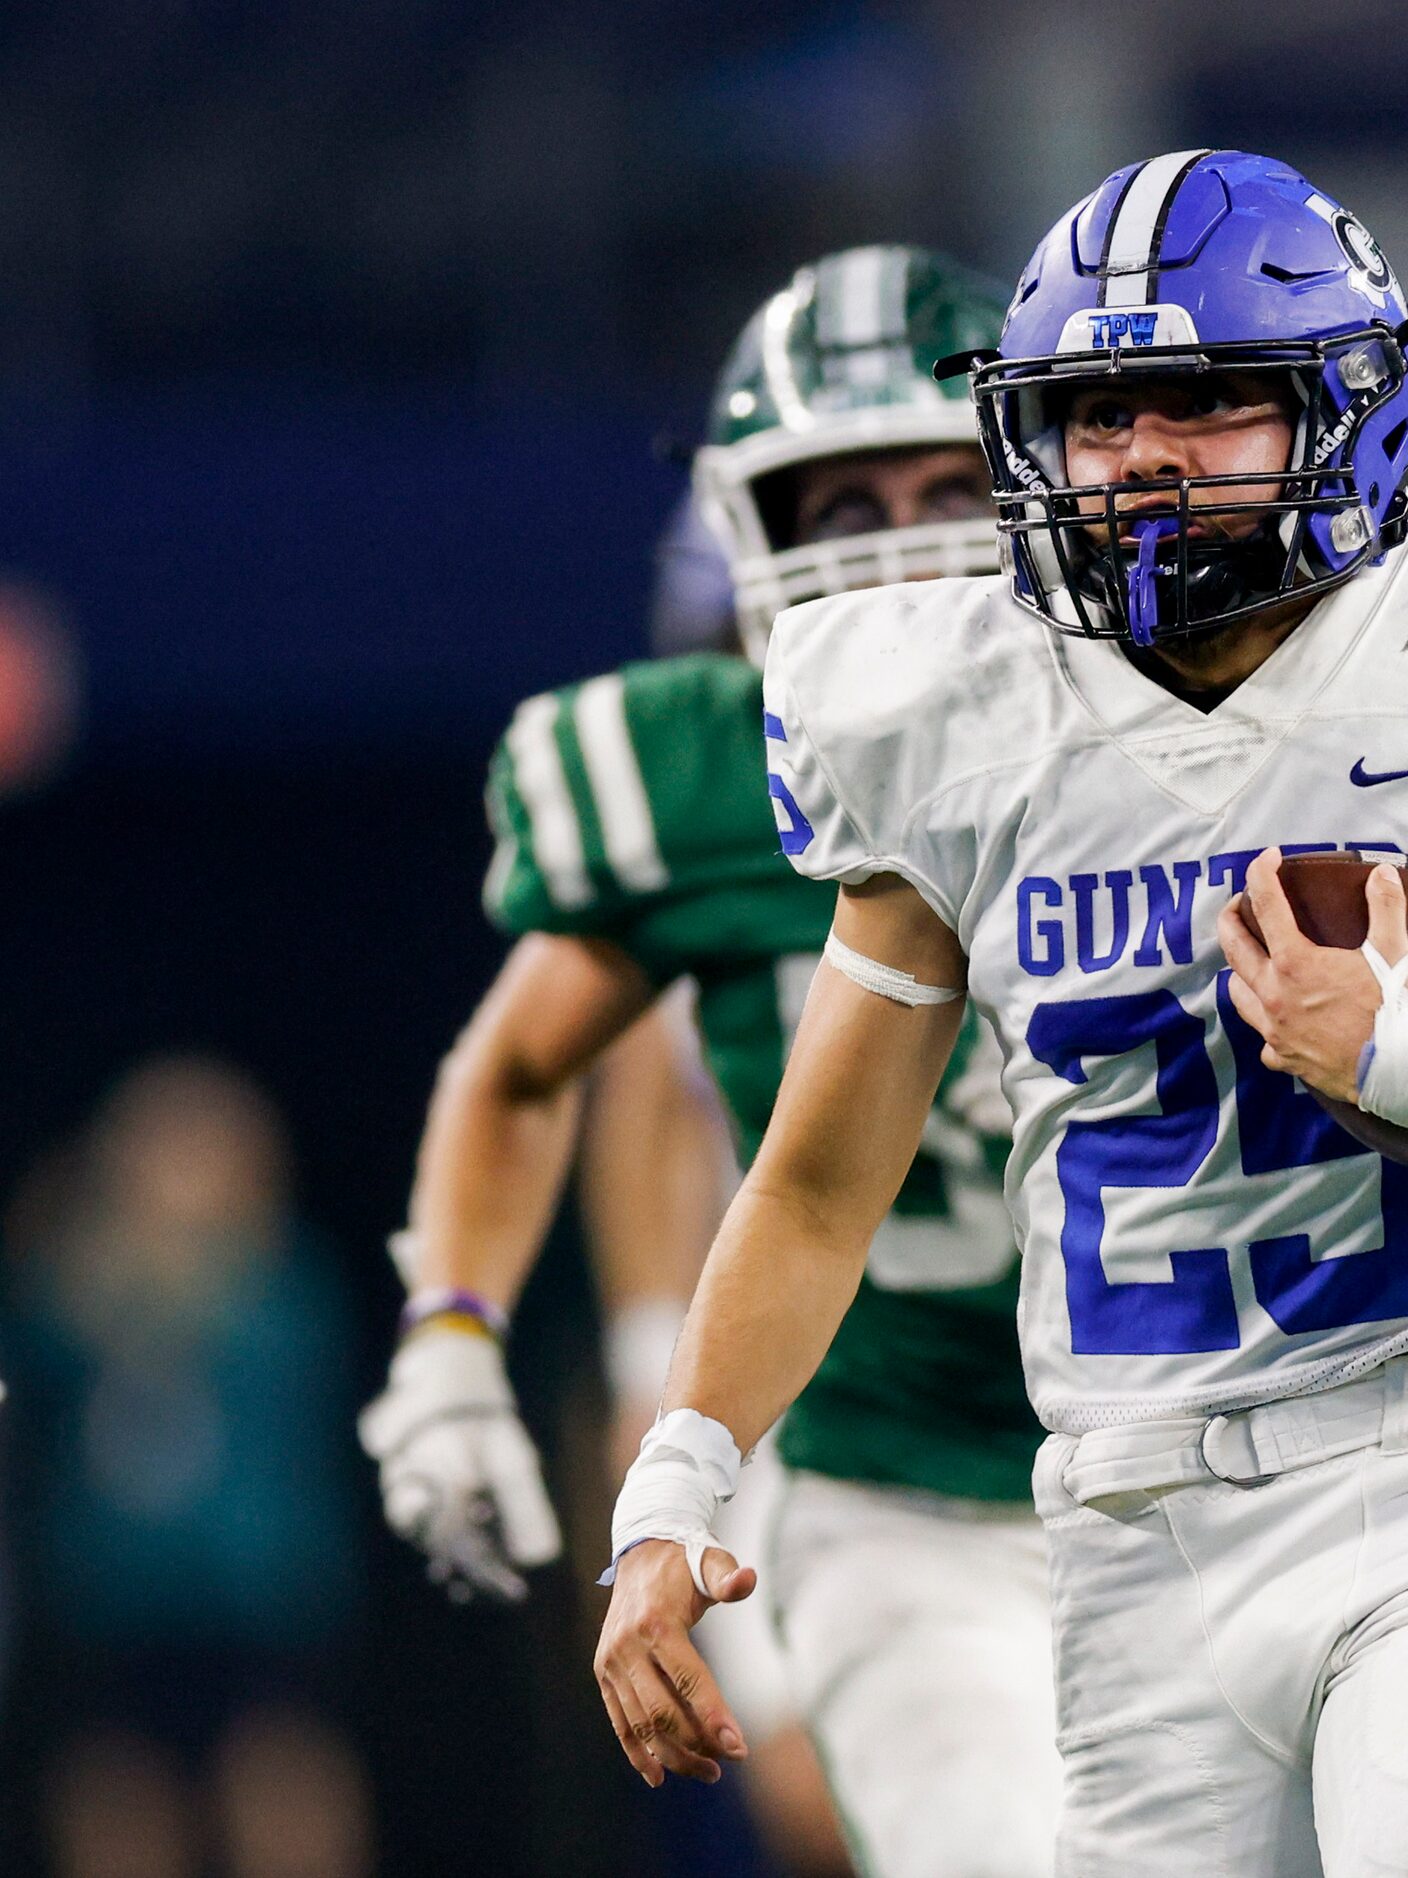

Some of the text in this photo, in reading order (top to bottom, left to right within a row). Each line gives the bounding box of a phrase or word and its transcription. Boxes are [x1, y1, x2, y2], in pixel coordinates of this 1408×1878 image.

[1088, 312, 1158, 348] TPW
[1313, 409, 1357, 465] ddell
[764, 711, 815, 855] 5
